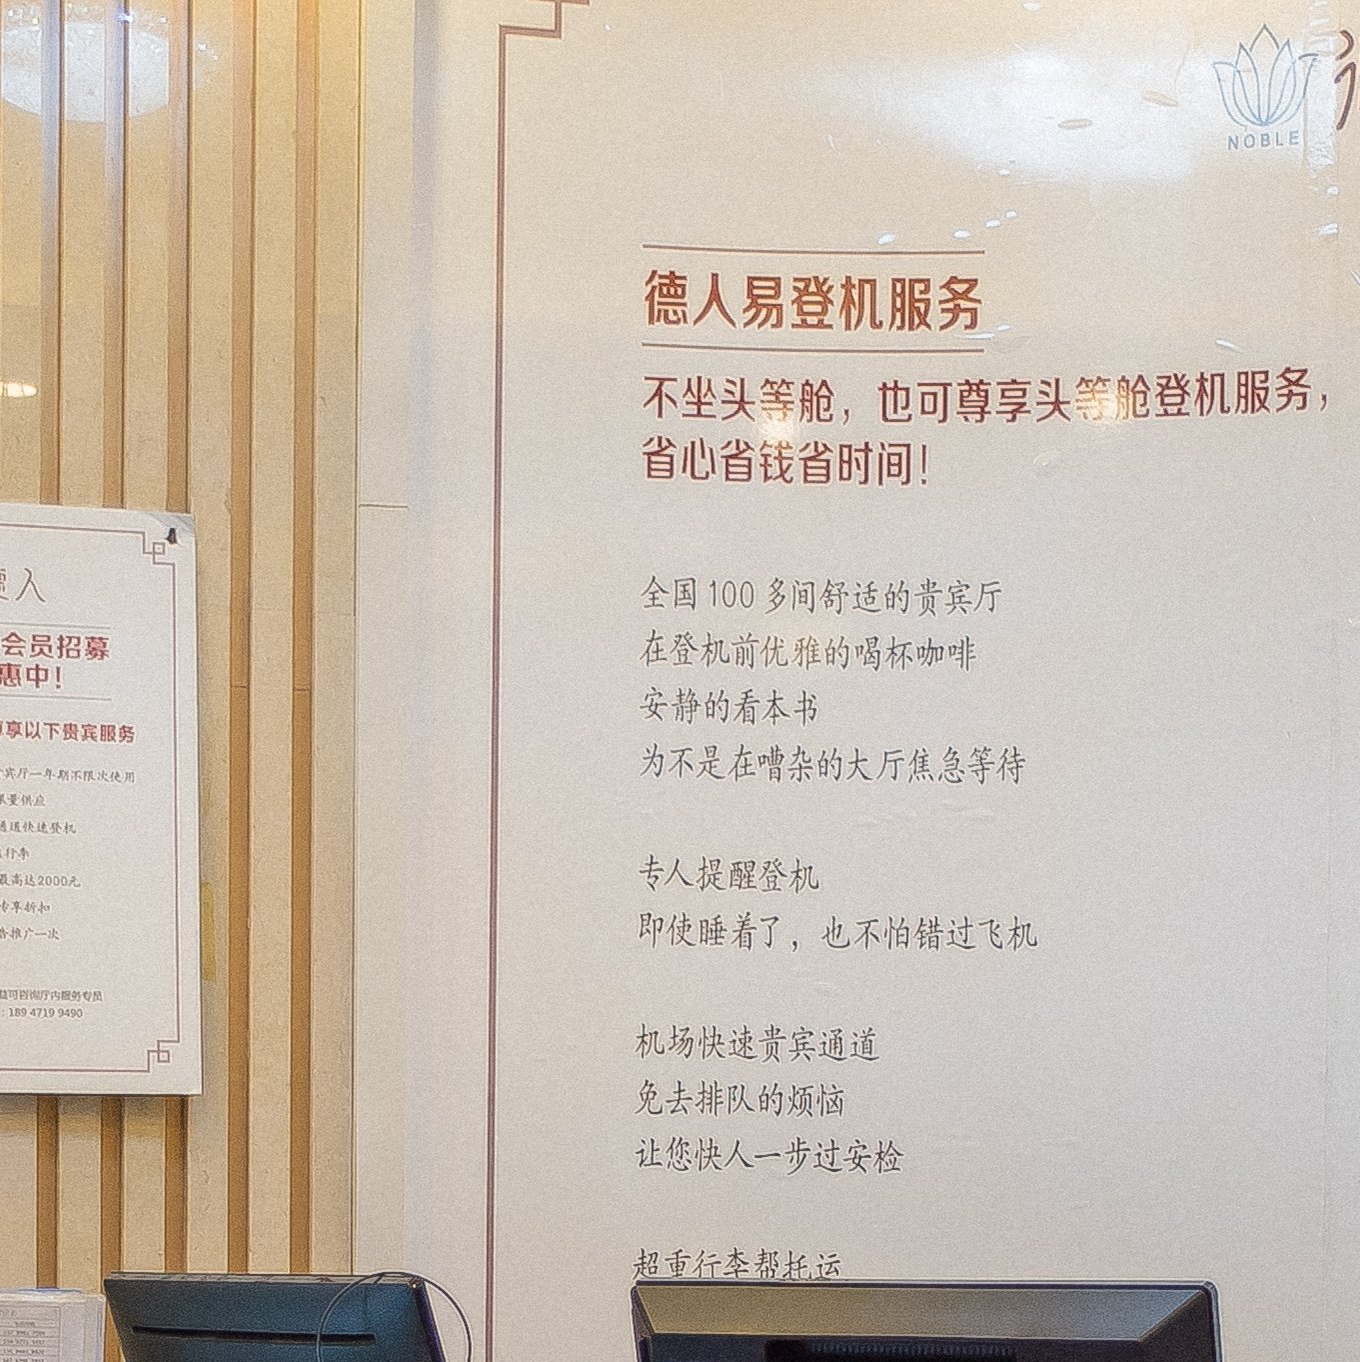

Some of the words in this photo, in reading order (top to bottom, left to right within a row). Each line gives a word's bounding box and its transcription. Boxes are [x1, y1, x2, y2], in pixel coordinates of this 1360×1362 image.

[1227, 130, 1300, 150] NOBLE
[644, 270, 983, 332] 德人易登机服务
[642, 437, 929, 486] 省心省钱省时间！
[640, 576, 699, 612] 全国
[710, 578, 755, 611] 100
[765, 579, 1002, 617] 多间舒适的贵宾厅
[640, 629, 977, 671] 在登机前优雅的喝杯咖啡
[640, 689, 818, 726] 安静的看本书
[640, 744, 1026, 785] 为不是在嘈杂的大厅焦急等待
[639, 856, 820, 892] 专人提醒登机
[639, 912, 1039, 951] 即使睡着了，也不怕错过飞机
[635, 1024, 880, 1064] 机场快速贵宾通道
[633, 1079, 845, 1118] 免去排队的烦恼
[635, 1138, 903, 1175] 让您快人一步过安检
[633, 1247, 841, 1279] 超重行李帮托运
